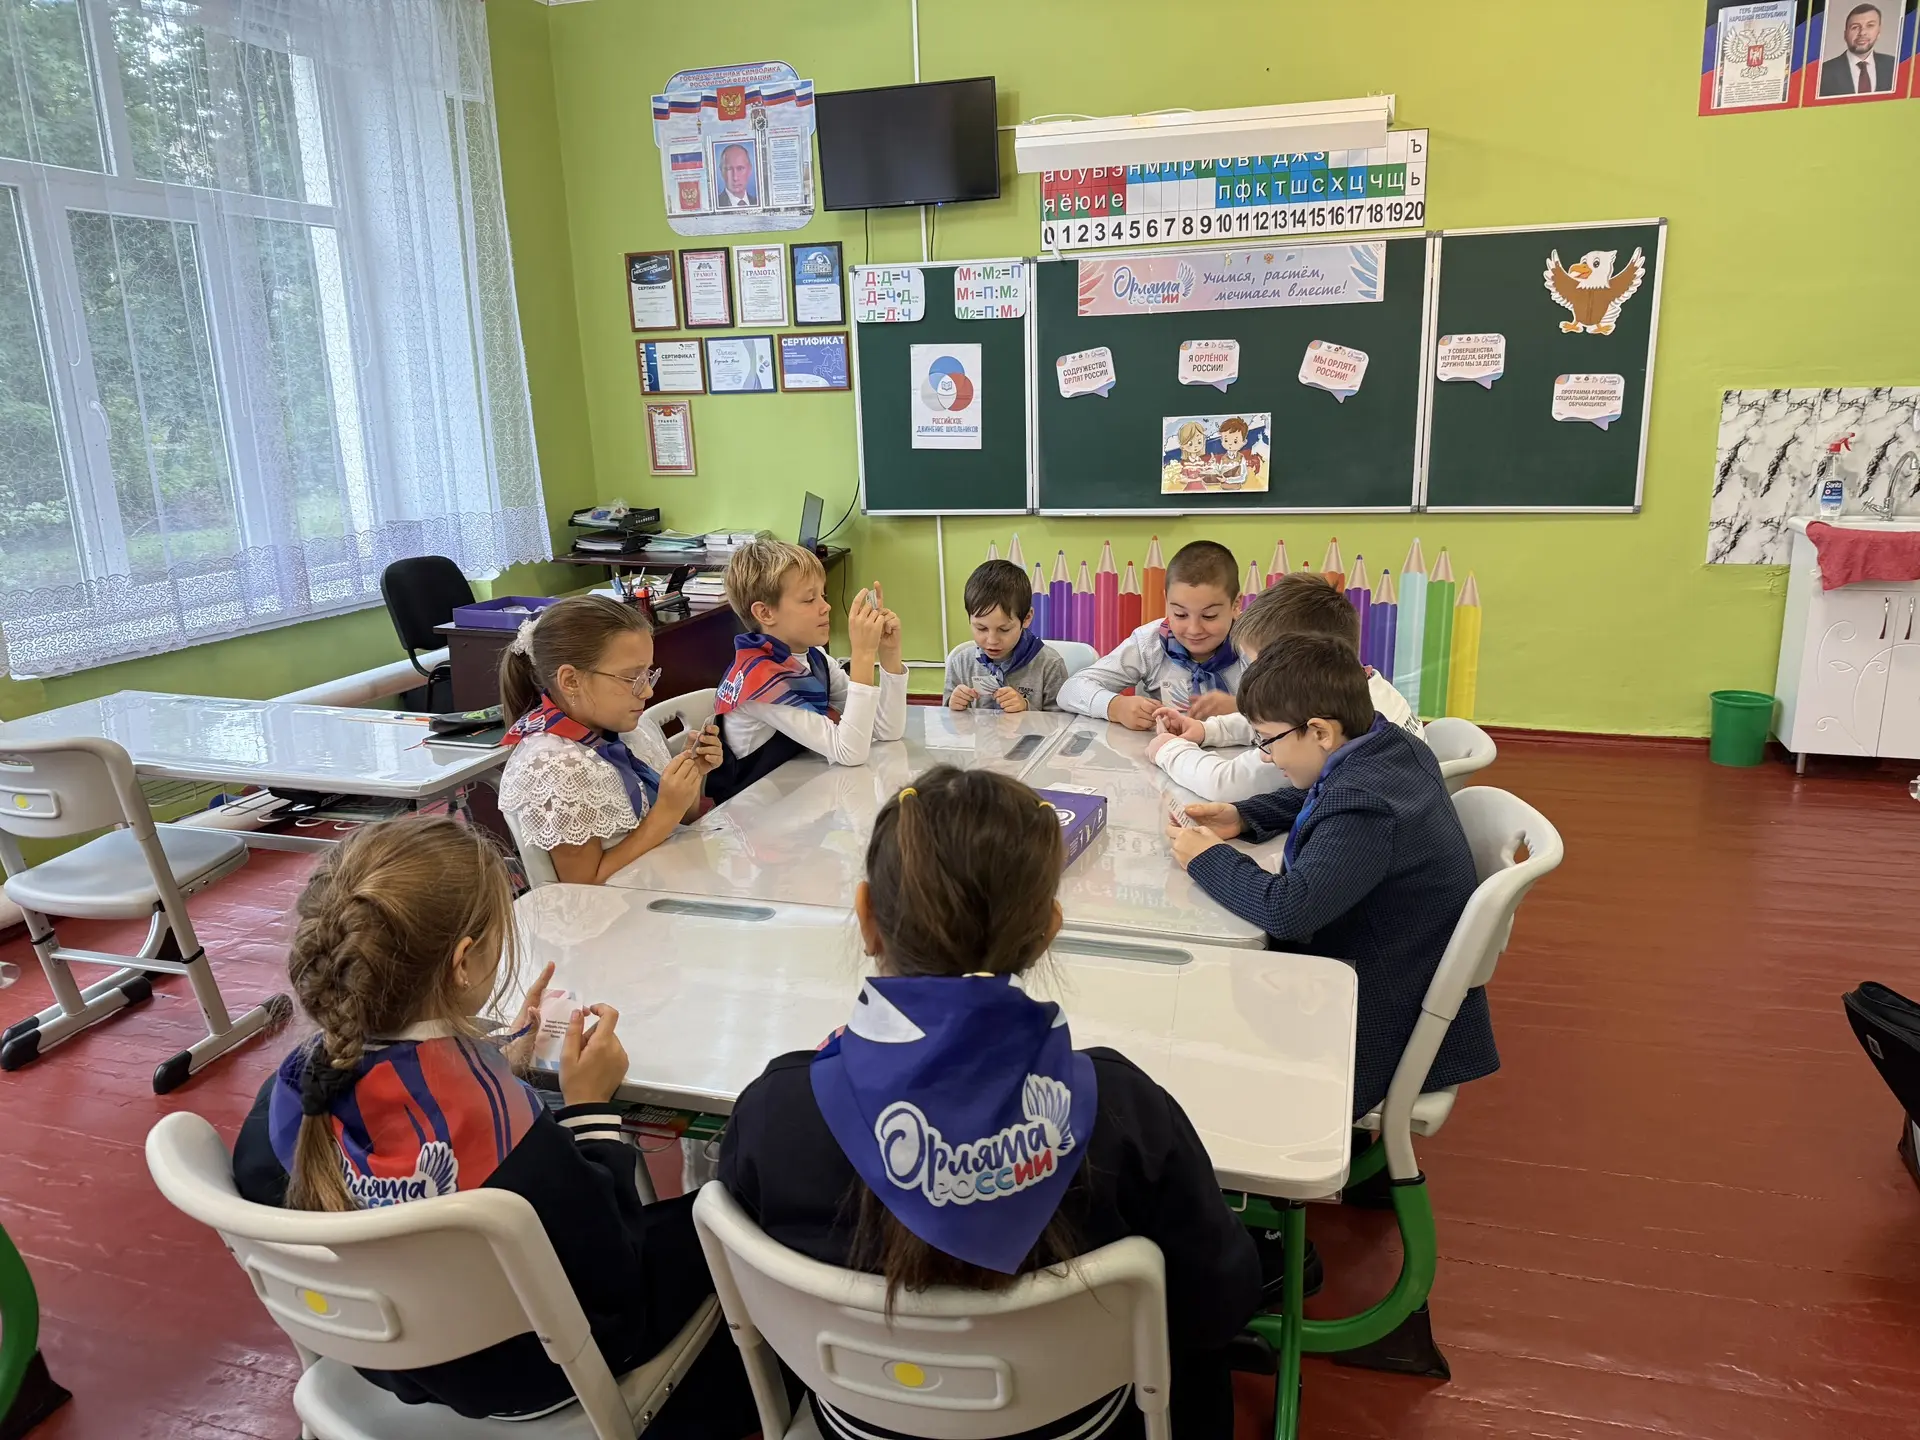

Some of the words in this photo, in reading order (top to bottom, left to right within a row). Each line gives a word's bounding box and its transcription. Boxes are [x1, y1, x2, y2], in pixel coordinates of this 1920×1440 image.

[1755, 11, 1788, 19] РЕСПУБЛИКИ
[1063, 225, 1070, 243] 1
[1078, 224, 1089, 243] 2
[1095, 223, 1106, 241] 3
[1111, 222, 1124, 240] 4
[1129, 220, 1140, 239] 5
[1146, 219, 1158, 237] 6
[1164, 218, 1176, 236] 7
[1182, 217, 1194, 235] 8
[1200, 215, 1212, 234] 9
[1216, 214, 1232, 233] 10
[1236, 212, 1249, 231] 11
[1253, 211, 1269, 230] 12
[1271, 210, 1287, 229] 13
[1290, 209, 1306, 228] 14
[1309, 208, 1325, 227] 15
[1328, 206, 1345, 225] 16
[1347, 205, 1364, 224] 17
[1366, 204, 1383, 223] 18
[1386, 202, 1403, 222] 19
[1404, 201, 1424, 221] 20
[746, 269, 776, 277] ГРАМОТА
[1203, 272, 1256, 285] Учимся,
[1263, 266, 1325, 285] растём,
[1114, 266, 1180, 300] Орлята
[1215, 289, 1281, 301] мечтаем
[1287, 280, 1348, 296] вместе!
[782, 336, 845, 346] СЕРТИФИКАТ
[1063, 361, 1106, 377] СОДРУЖЕСТВО
[1192, 364, 1224, 372] РОССИИ!
[1313, 355, 1327, 365] МЫ
[1327, 359, 1357, 373] ОРЛЯТА
[1064, 374, 1084, 384] ОРЛЯТ
[1084, 369, 1109, 380] РОССИИ
[1316, 366, 1348, 381] РОССИИ!
[932, 416, 962, 424] РОССИЙСКОЕ
[916, 425, 943, 433] ДВИЖЕНИЕ
[881, 1108, 1051, 1192] Орлята
